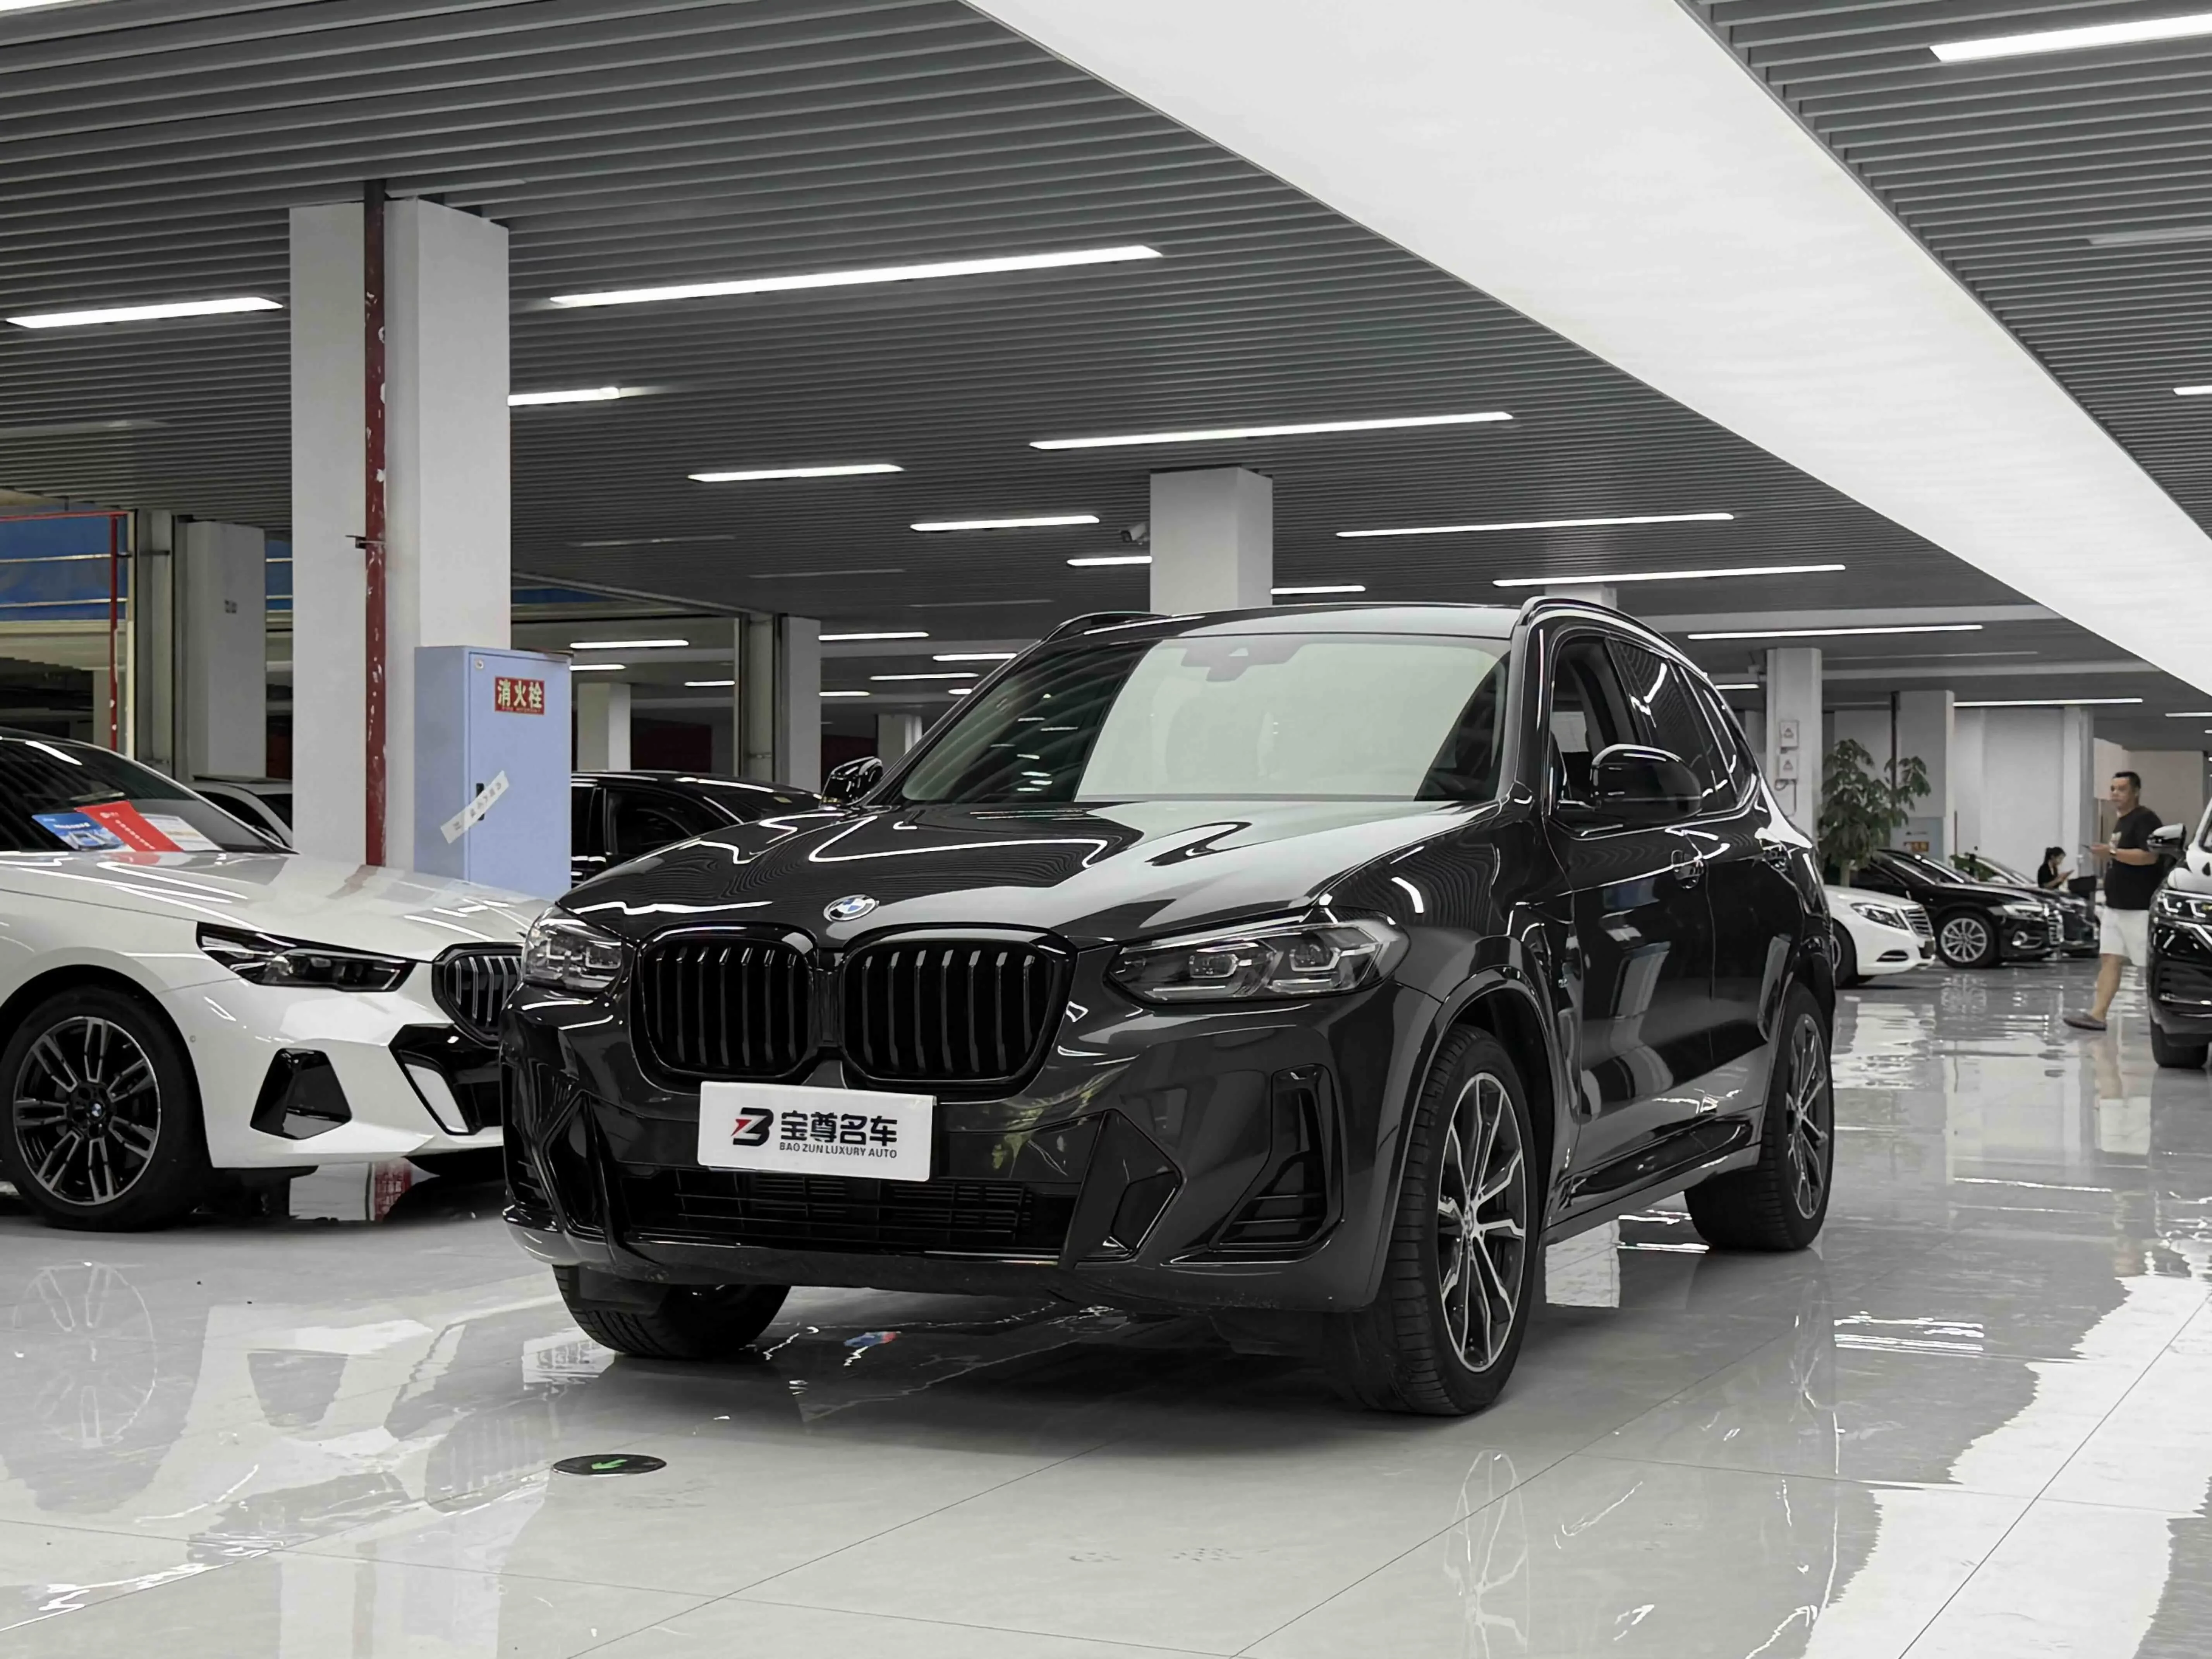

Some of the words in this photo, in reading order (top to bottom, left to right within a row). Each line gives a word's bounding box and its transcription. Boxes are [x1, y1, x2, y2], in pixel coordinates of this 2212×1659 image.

[498, 678, 542, 708] 消火栓
[781, 1110, 897, 1146] 宝尊名车
[780, 1142, 800, 1152] BAO
[802, 1144, 823, 1153] ZUN
[826, 1145, 866, 1156] LUXURY
[868, 1148, 897, 1158] AUTO
